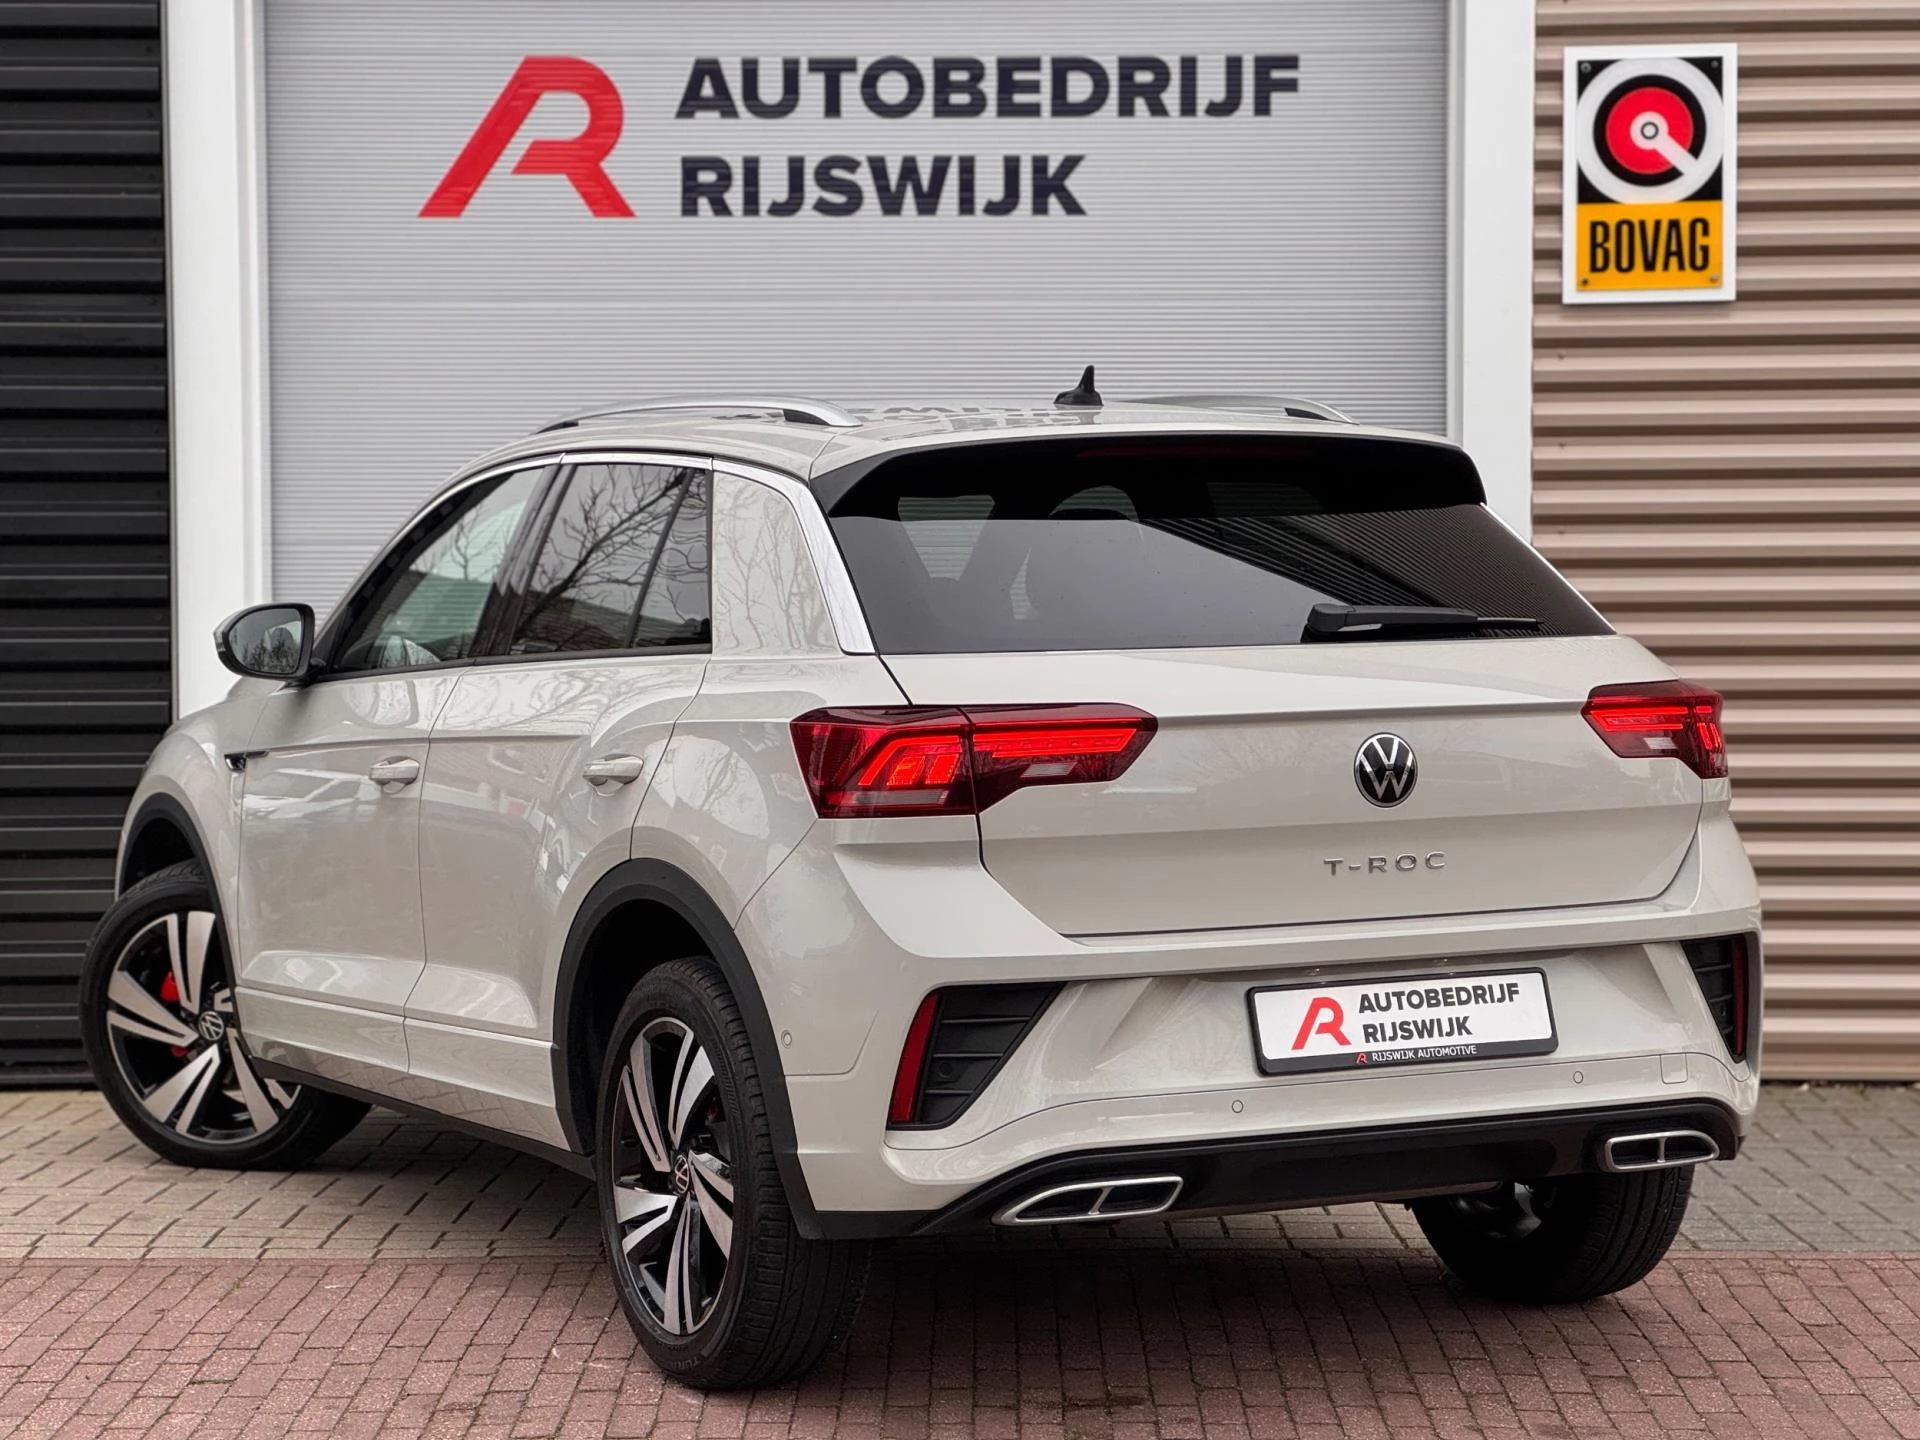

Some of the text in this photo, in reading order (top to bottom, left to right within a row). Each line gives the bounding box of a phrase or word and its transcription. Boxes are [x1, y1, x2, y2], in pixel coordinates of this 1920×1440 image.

[676, 55, 1299, 119] AUTOBEDRIJF
[681, 154, 1086, 217] RIJSWIJK
[1589, 217, 1710, 274] BOVAG
[1323, 851, 1446, 876] T-ROC
[1358, 982, 1520, 1014] AUTOBEDRIJF
[1362, 1015, 1473, 1044] RIJSWIJK
[1371, 1048, 1415, 1062] RIJSWIJK
[1417, 1045, 1477, 1059] AUTOMOTIVE
